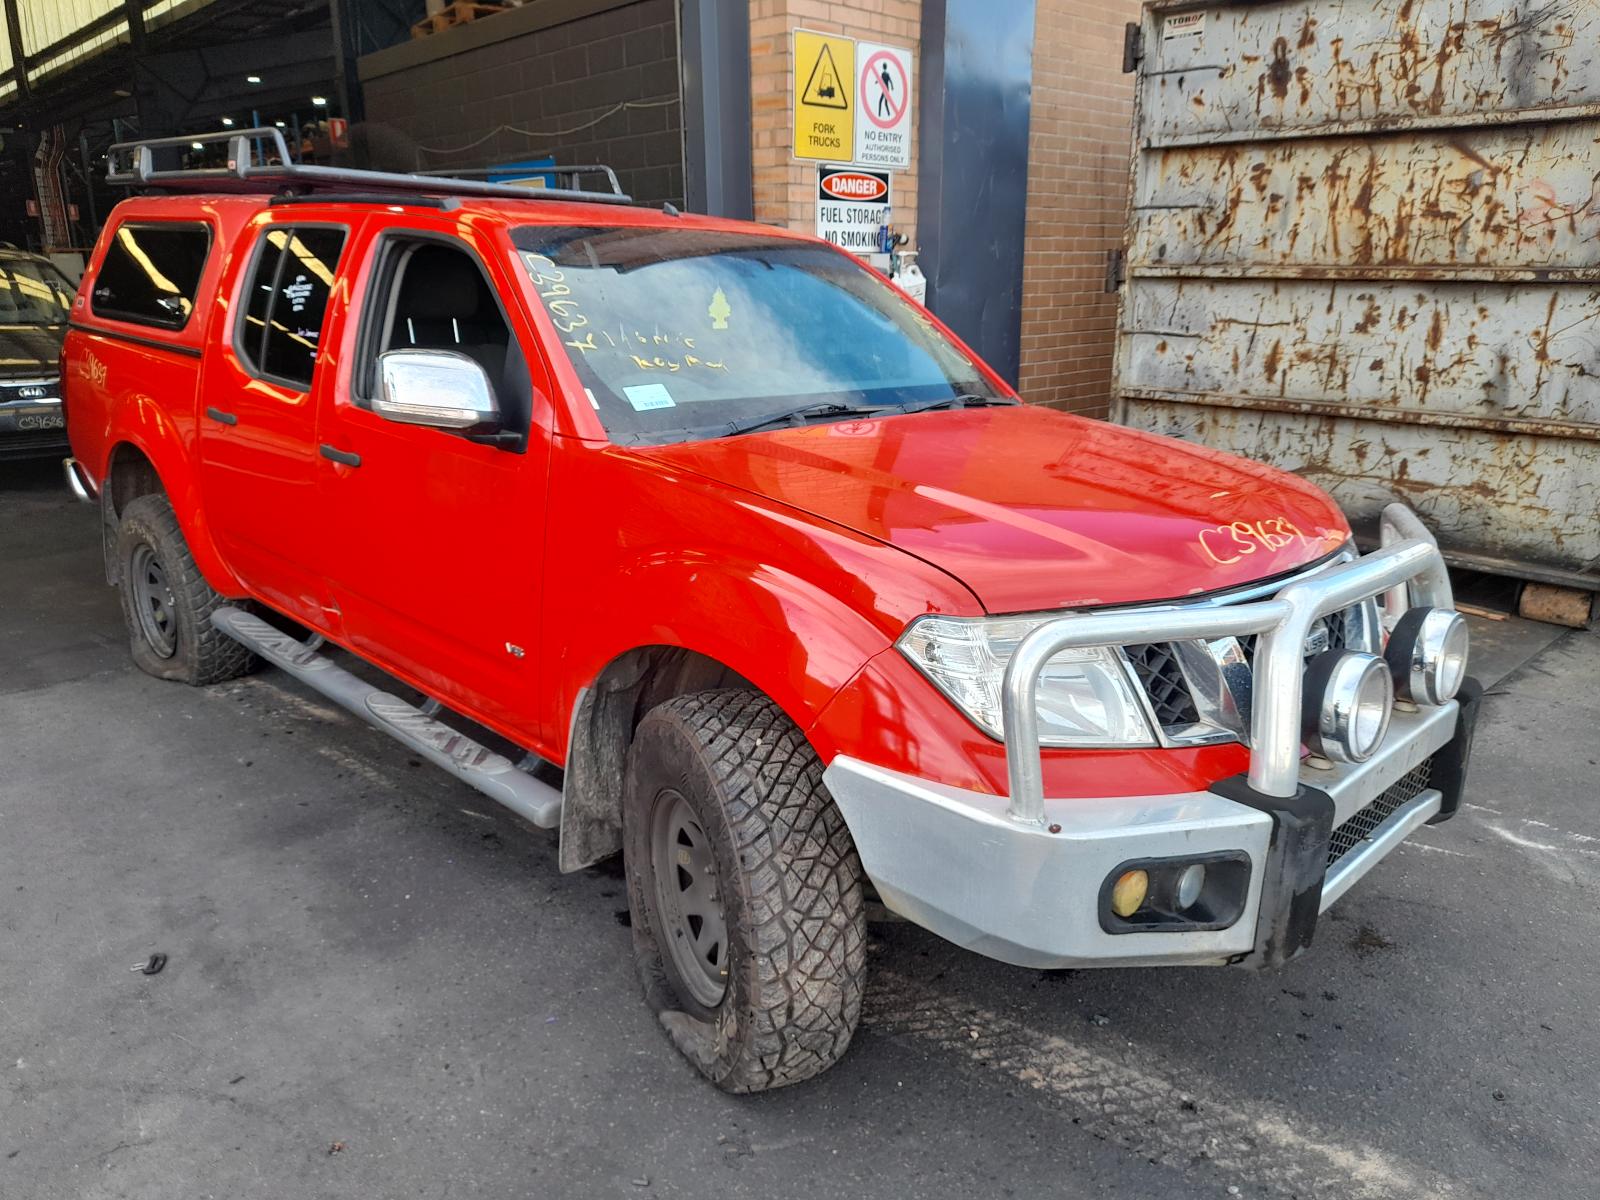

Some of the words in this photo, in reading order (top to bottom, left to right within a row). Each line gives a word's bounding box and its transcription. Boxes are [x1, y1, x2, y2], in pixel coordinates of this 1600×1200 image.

[813, 122, 836, 134] FORK
[808, 135, 841, 148] TRUCKS
[864, 130, 876, 141] NO
[878, 131, 902, 143] ENTRY
[865, 144, 901, 153] AUTHORISED
[862, 153, 888, 161] PERSONS
[890, 155, 904, 163] ONLY
[832, 177, 877, 194] DANGER
[821, 207, 843, 223] FUEL
[846, 208, 883, 224] STORAG
[825, 230, 838, 245] NO
[21, 386, 45, 398] KIA
